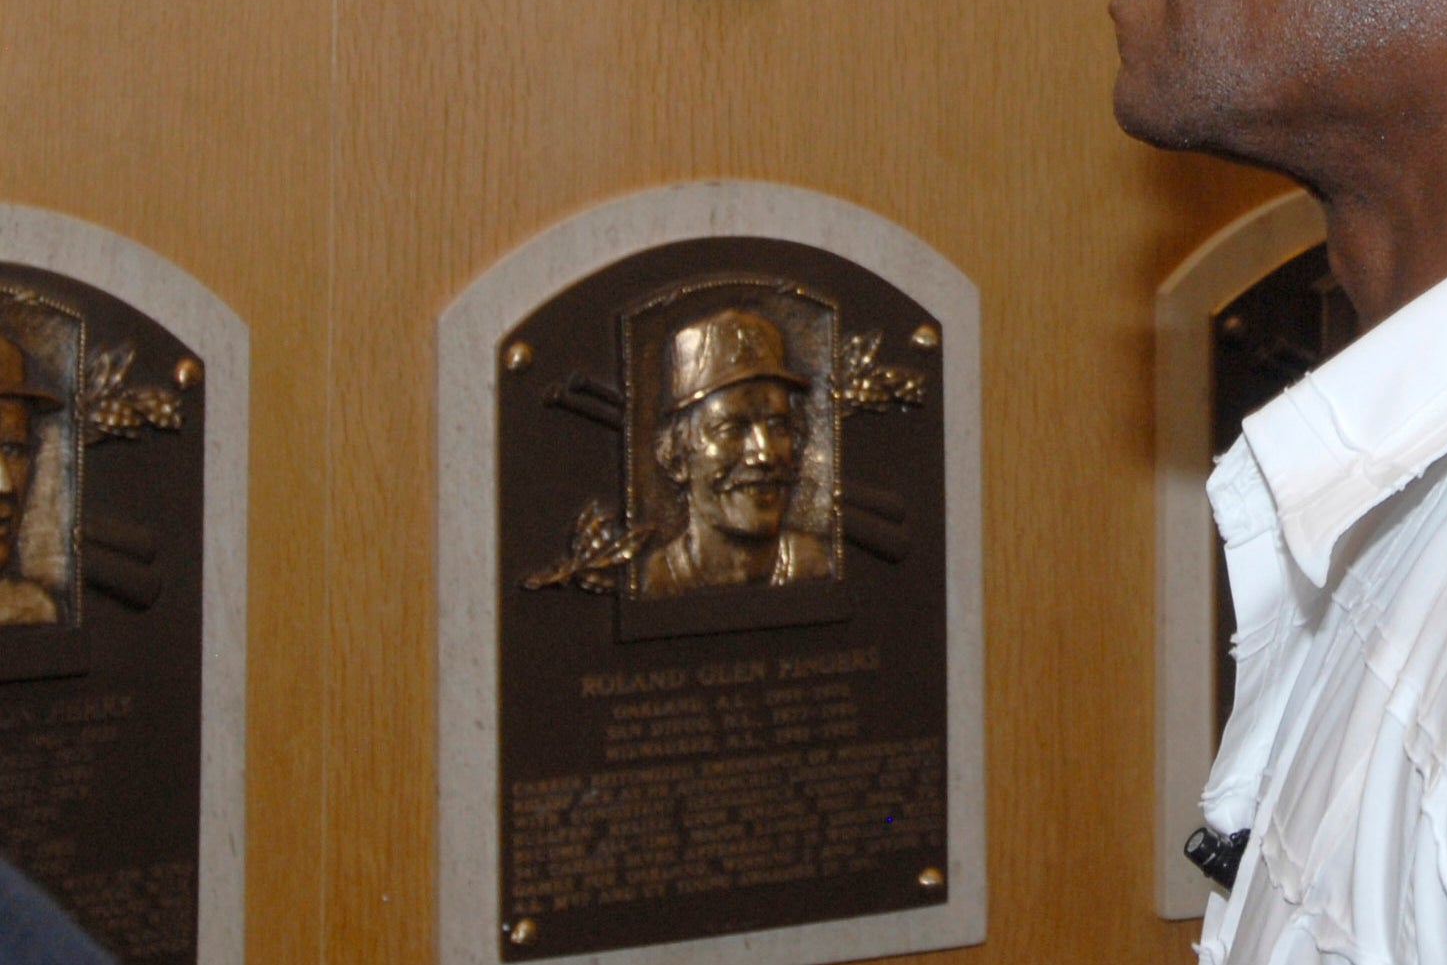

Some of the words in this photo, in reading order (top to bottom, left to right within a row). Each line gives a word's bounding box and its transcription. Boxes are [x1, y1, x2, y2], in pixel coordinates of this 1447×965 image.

[581, 667, 686, 698] ROLAND
[697, 658, 767, 686] GLEN
[779, 646, 881, 679] FINGERS
